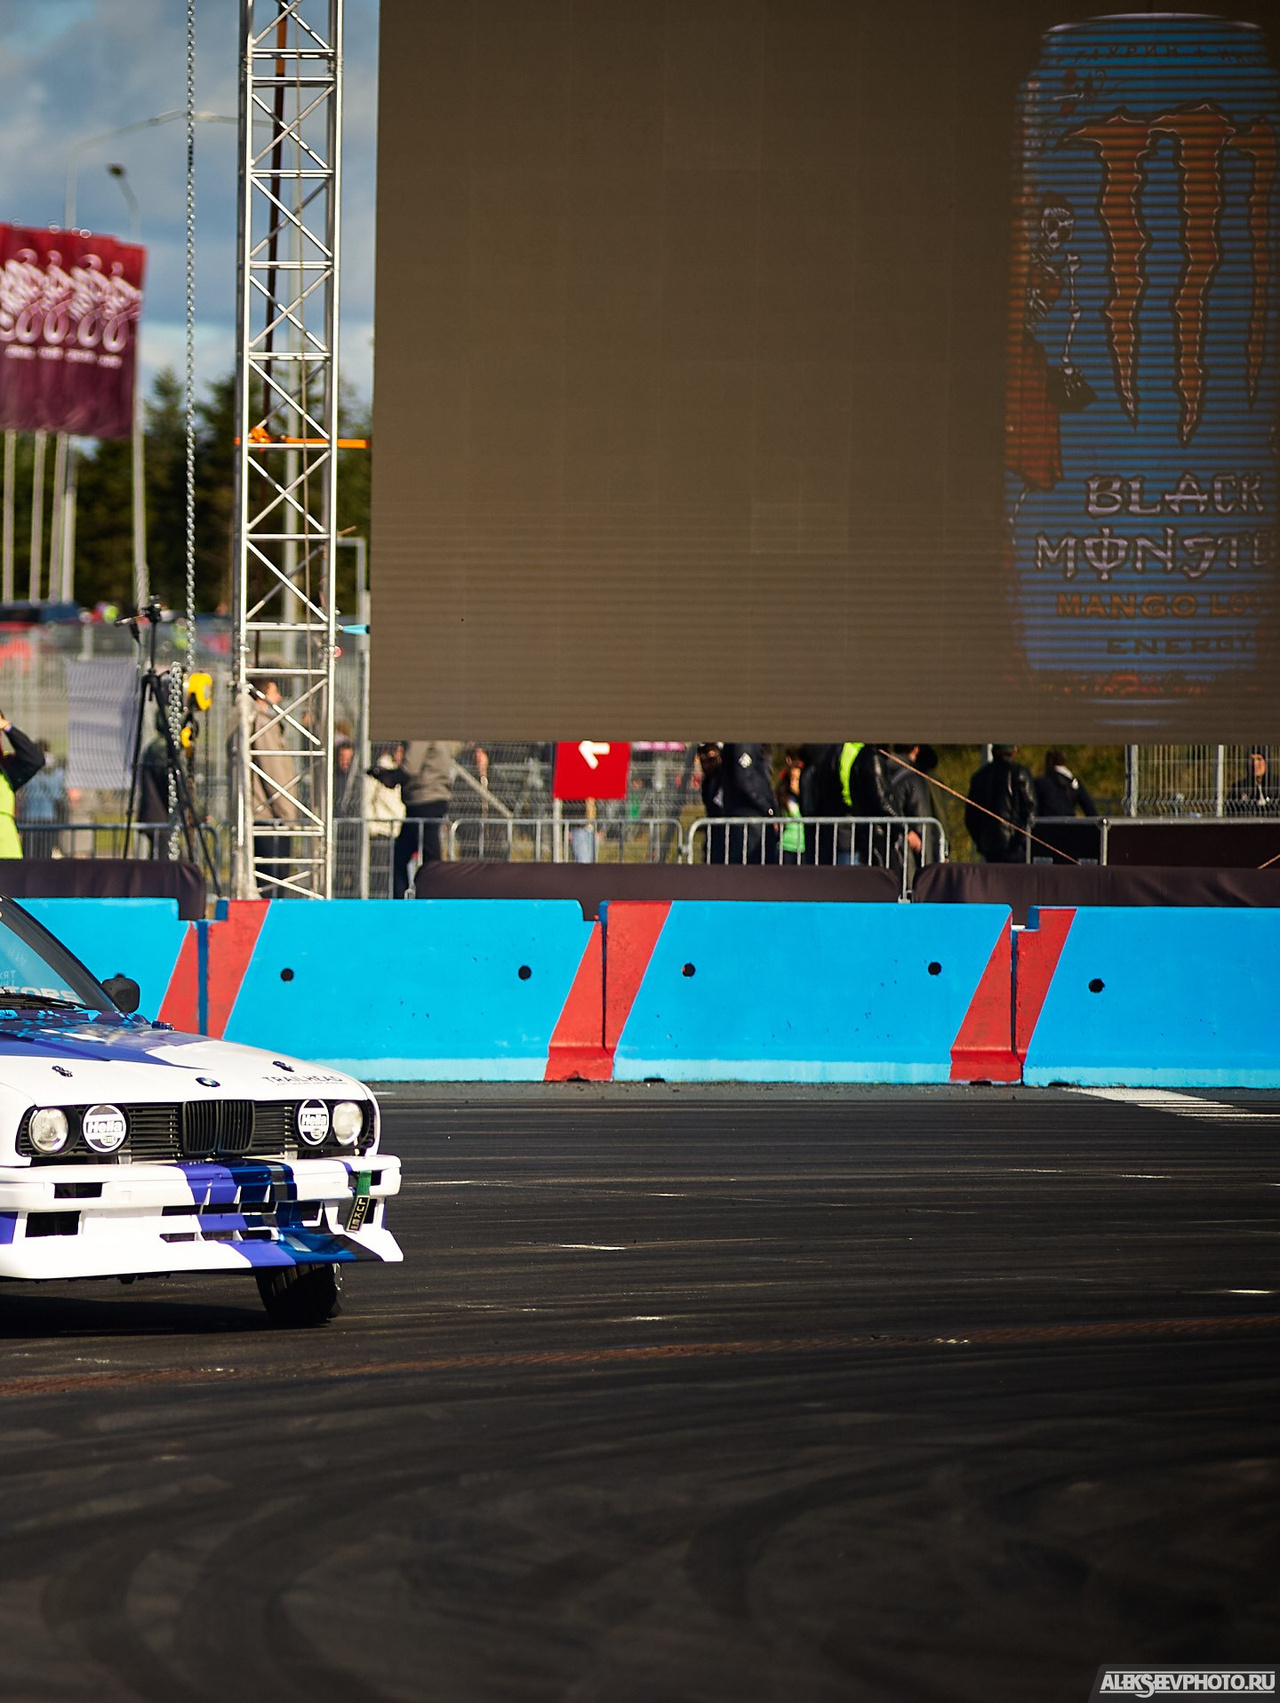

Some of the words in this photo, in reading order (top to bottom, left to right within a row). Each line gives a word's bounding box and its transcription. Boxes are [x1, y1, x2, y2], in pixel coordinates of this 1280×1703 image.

[1087, 474, 1264, 514] BLACK
[1055, 593, 1198, 618] MANGO
[85, 1120, 124, 1134] Hella
[300, 1113, 328, 1126] Hella
